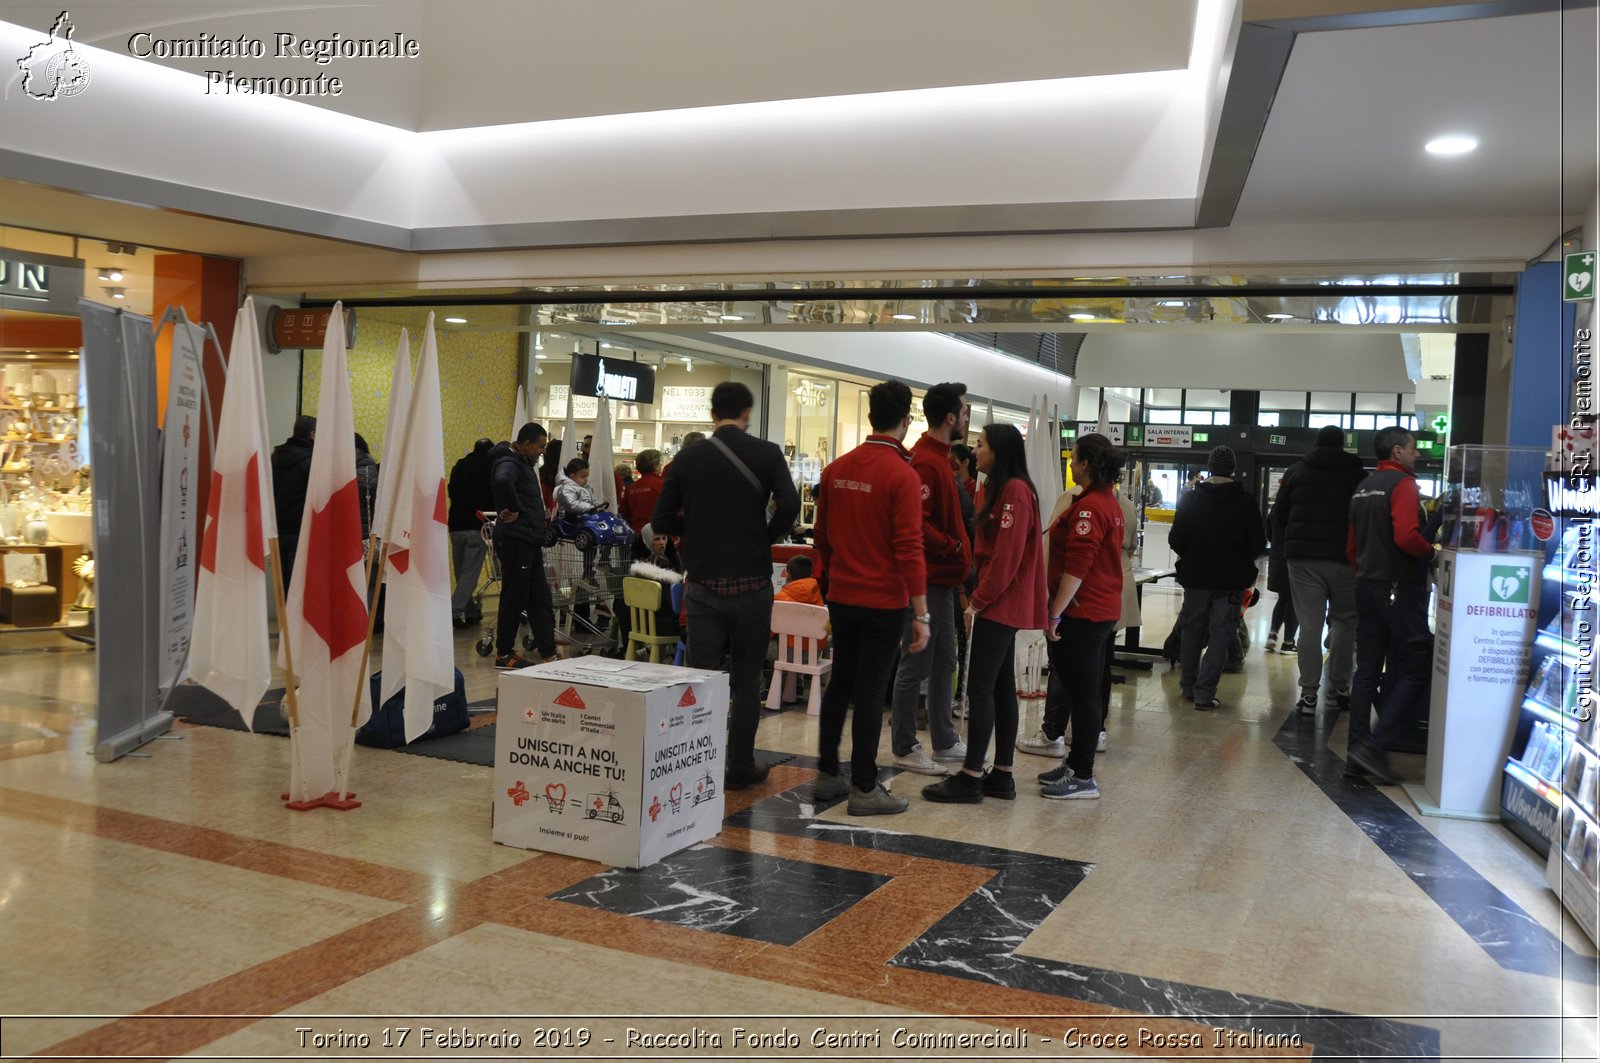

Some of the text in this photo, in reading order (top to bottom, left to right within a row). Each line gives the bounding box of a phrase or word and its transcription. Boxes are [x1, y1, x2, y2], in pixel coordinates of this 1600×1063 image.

[0, 259, 49, 292] N
[663, 387, 706, 397] NEL 1933
[673, 411, 698, 419] MOKA
[580, 719, 616, 730] Commerciali
[583, 713, 601, 721] Centri
[517, 736, 619, 766] UNISCITI A NOI,
[654, 734, 713, 763] UNISCITI A NOI,
[509, 751, 626, 781] DONA ANCHE TU!
[650, 747, 717, 781] DONA ANCHE TU!
[539, 826, 566, 837] Insieme
[573, 833, 590, 842] può!
